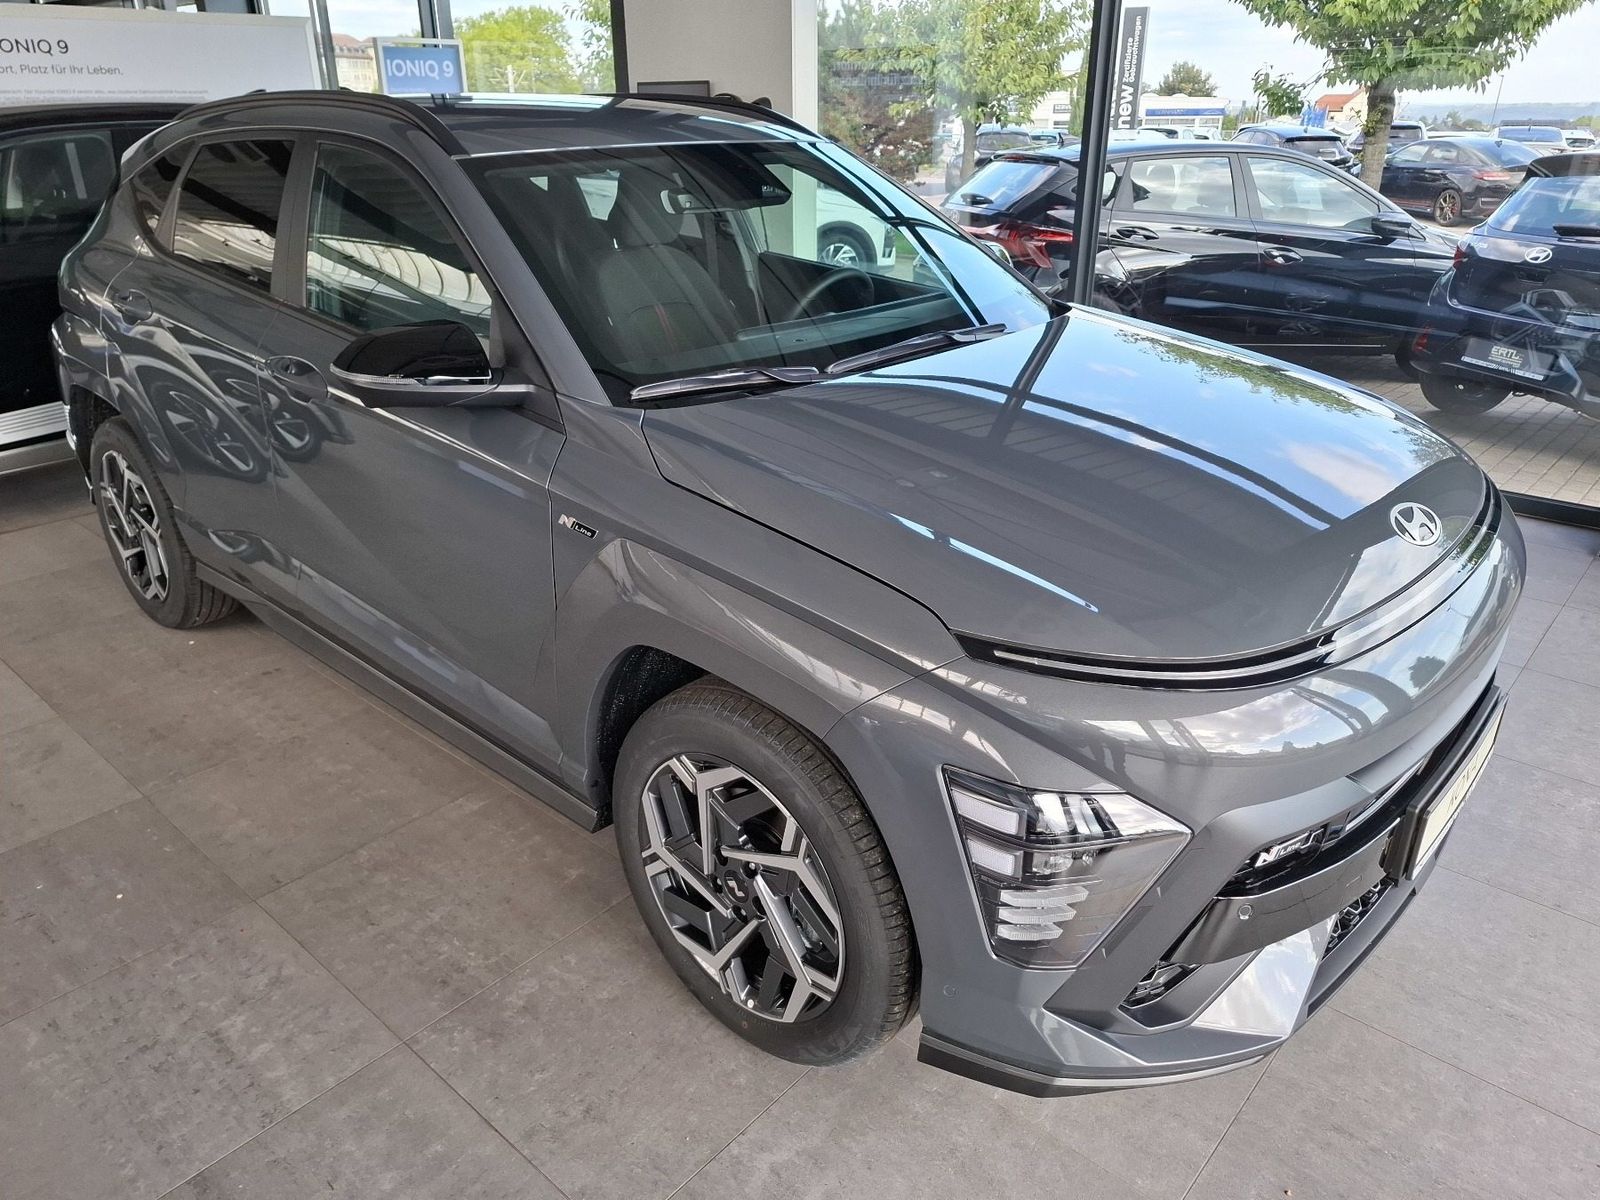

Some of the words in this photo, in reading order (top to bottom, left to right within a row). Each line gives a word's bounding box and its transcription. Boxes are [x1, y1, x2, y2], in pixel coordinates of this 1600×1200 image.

[57, 39, 69, 54] 9
[1128, 15, 1142, 82] Gebrauchtwagen
[19, 64, 49, 75] Platz
[51, 64, 66, 75] für
[70, 66, 84, 75] Ihr
[386, 58, 440, 80] IONIQ
[443, 60, 454, 78] 9
[1117, 84, 1134, 130] new
[1490, 345, 1520, 360] ERTL
[558, 513, 575, 530] N
[575, 524, 592, 537] Line
[1255, 845, 1280, 867] N
